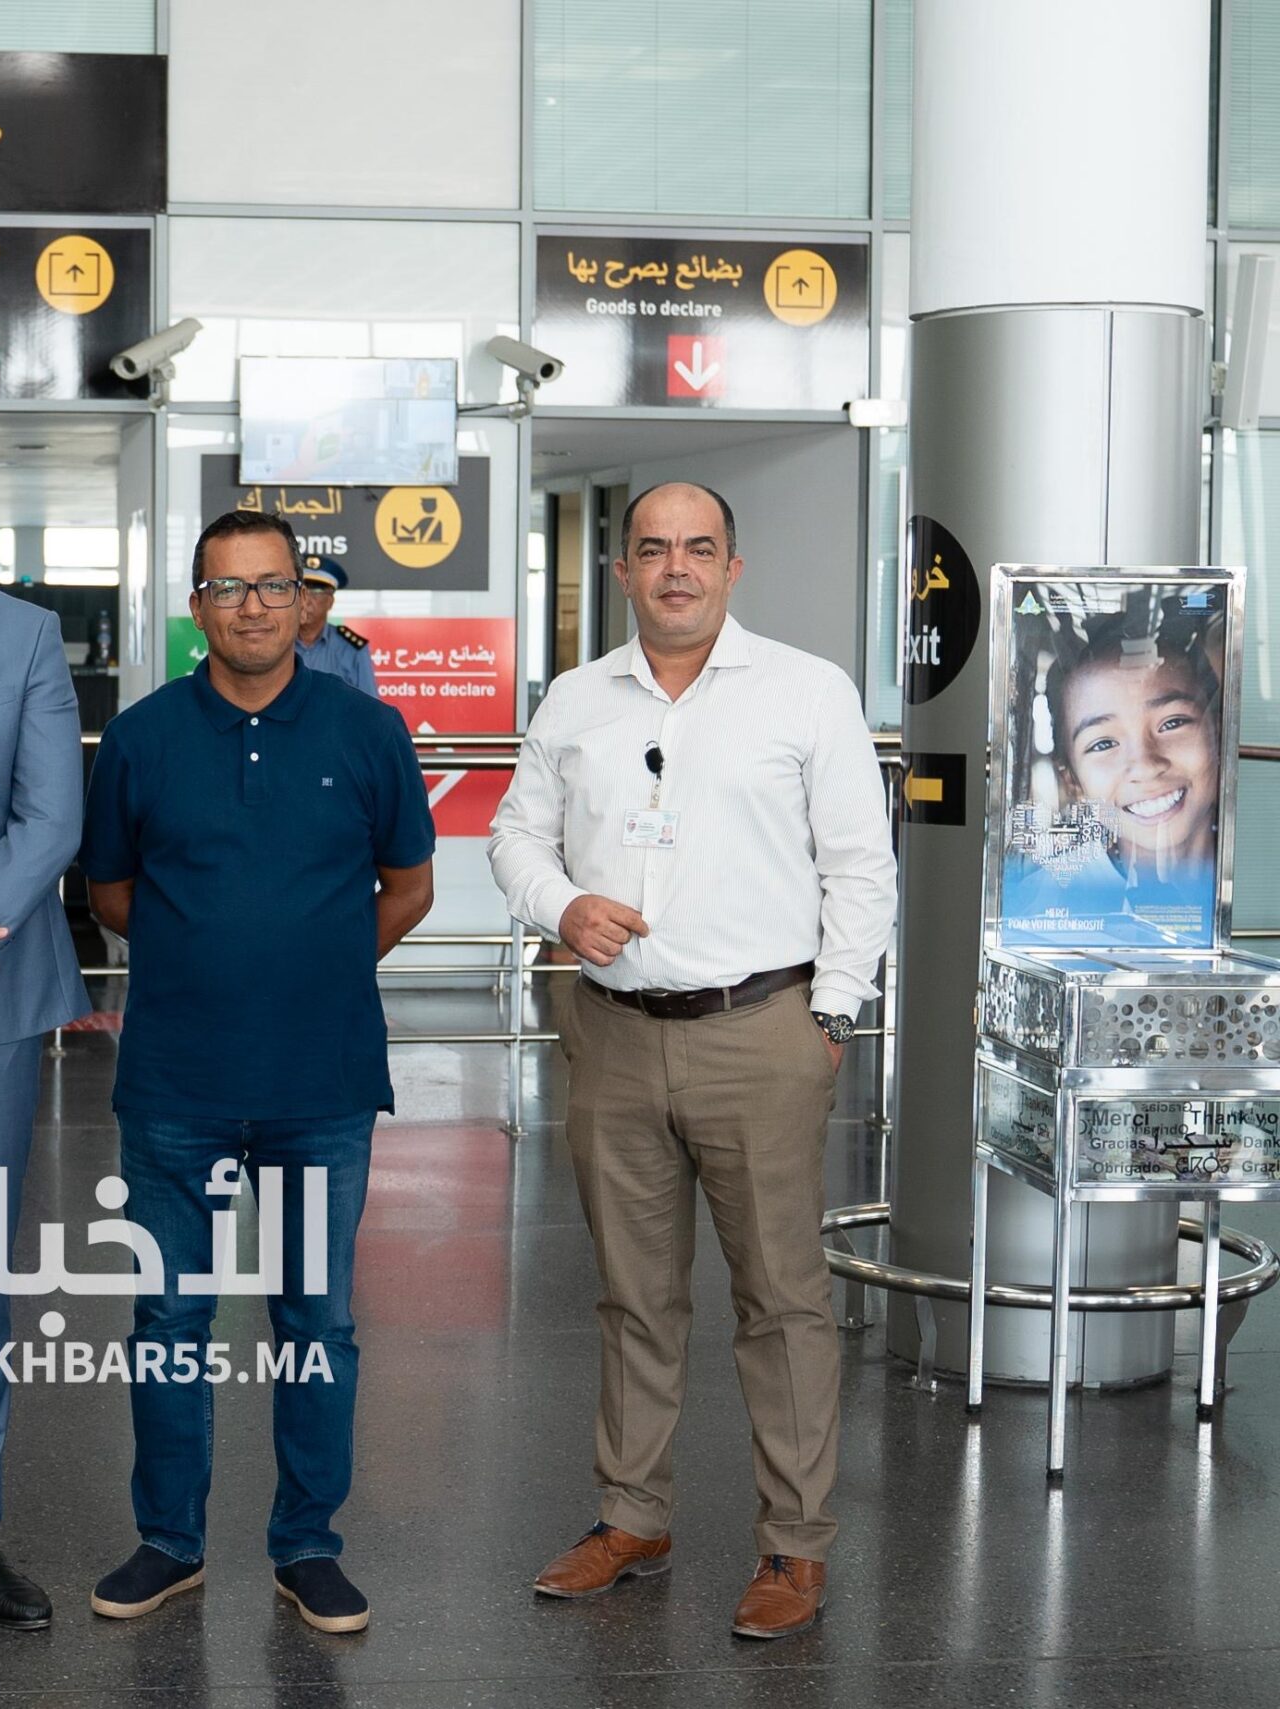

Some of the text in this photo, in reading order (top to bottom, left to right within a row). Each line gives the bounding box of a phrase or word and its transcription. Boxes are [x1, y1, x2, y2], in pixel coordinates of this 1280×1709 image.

[567, 252, 743, 290] بضائع يصرح بها
[586, 298, 722, 317] Goods to declare
[911, 553, 950, 601] خرو
[378, 682, 496, 697] oods to declare
[1092, 1109, 1279, 1128] Merci Thank yo
[1090, 1138, 1146, 1150] Gracias
[1243, 1135, 1280, 1149] Dank
[1092, 1161, 1161, 1176] Obrigado
[1241, 1159, 1280, 1173] Grazi
